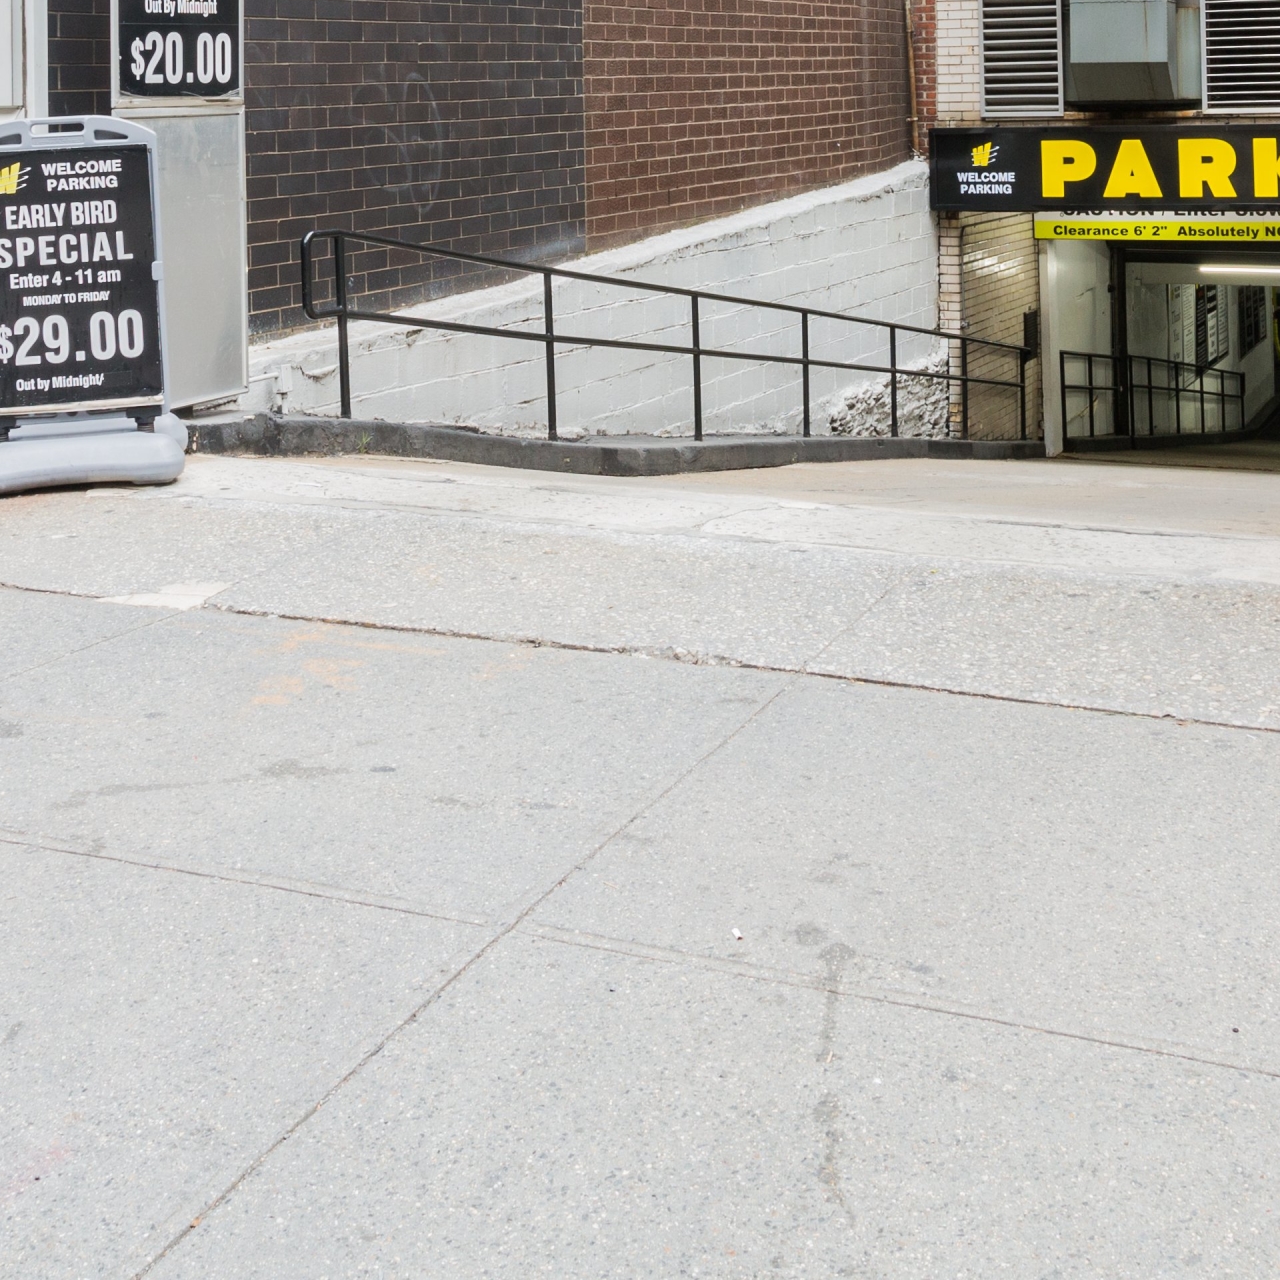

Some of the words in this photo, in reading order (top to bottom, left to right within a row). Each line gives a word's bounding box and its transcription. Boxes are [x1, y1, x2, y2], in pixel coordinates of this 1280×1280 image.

[130, 31, 232, 84] $20.00
[41, 159, 122, 177] WELCOME
[46, 174, 119, 192] PARKING
[957, 172, 1016, 183] WELCOME
[960, 184, 1012, 194] PARKING
[5, 204, 66, 231] EARLY
[70, 199, 117, 225] BIRD
[1053, 225, 1129, 236] Clearance
[1133, 225, 1147, 236] 6'
[1152, 225, 1168, 236] 2"
[1177, 226, 1260, 240] Absolutely
[9, 272, 49, 290] Enter
[51, 272, 62, 286] 4
[75, 270, 93, 285] 11
[97, 271, 121, 284] am
[22, 293, 62, 307] MONDAY
[63, 292, 77, 305] TO
[78, 290, 111, 303] FRIDAY
[16, 379, 35, 391] Out
[37, 377, 50, 392] by
